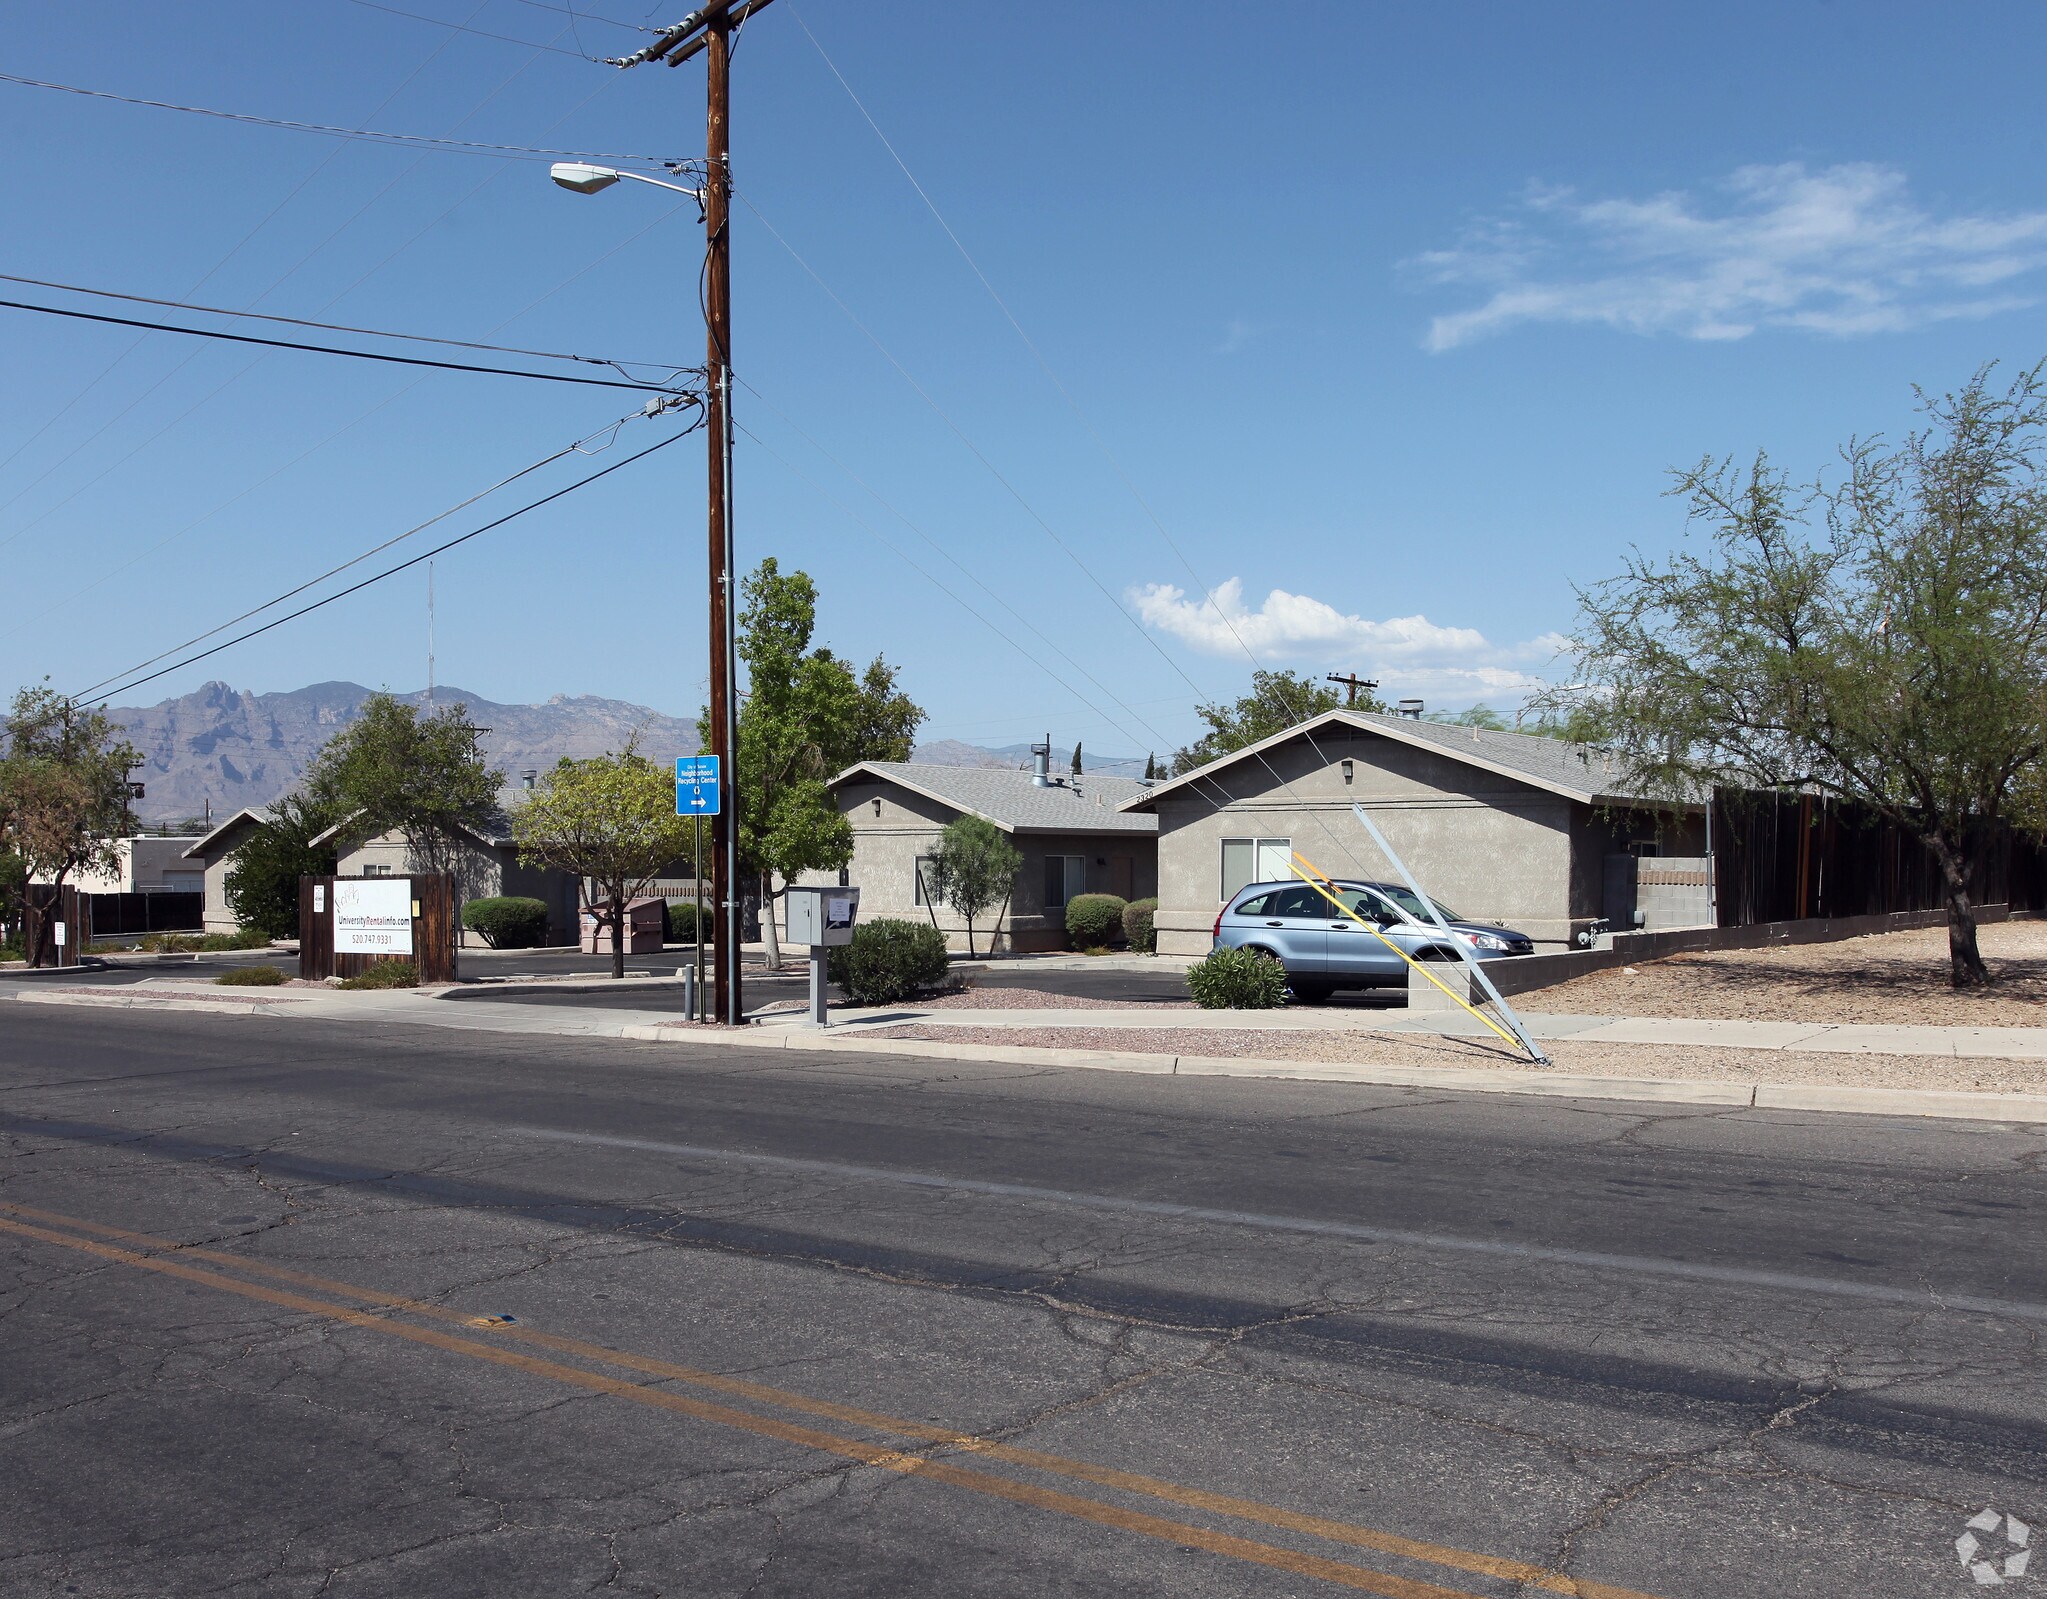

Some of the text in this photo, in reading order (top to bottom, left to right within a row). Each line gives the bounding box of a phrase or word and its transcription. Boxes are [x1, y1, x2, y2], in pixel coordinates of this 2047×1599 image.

[681, 769, 713, 777] Neighborhood
[678, 777, 699, 785] Recycling
[1136, 790, 1154, 803] 2320
[352, 934, 392, 945] 520.747.9331
